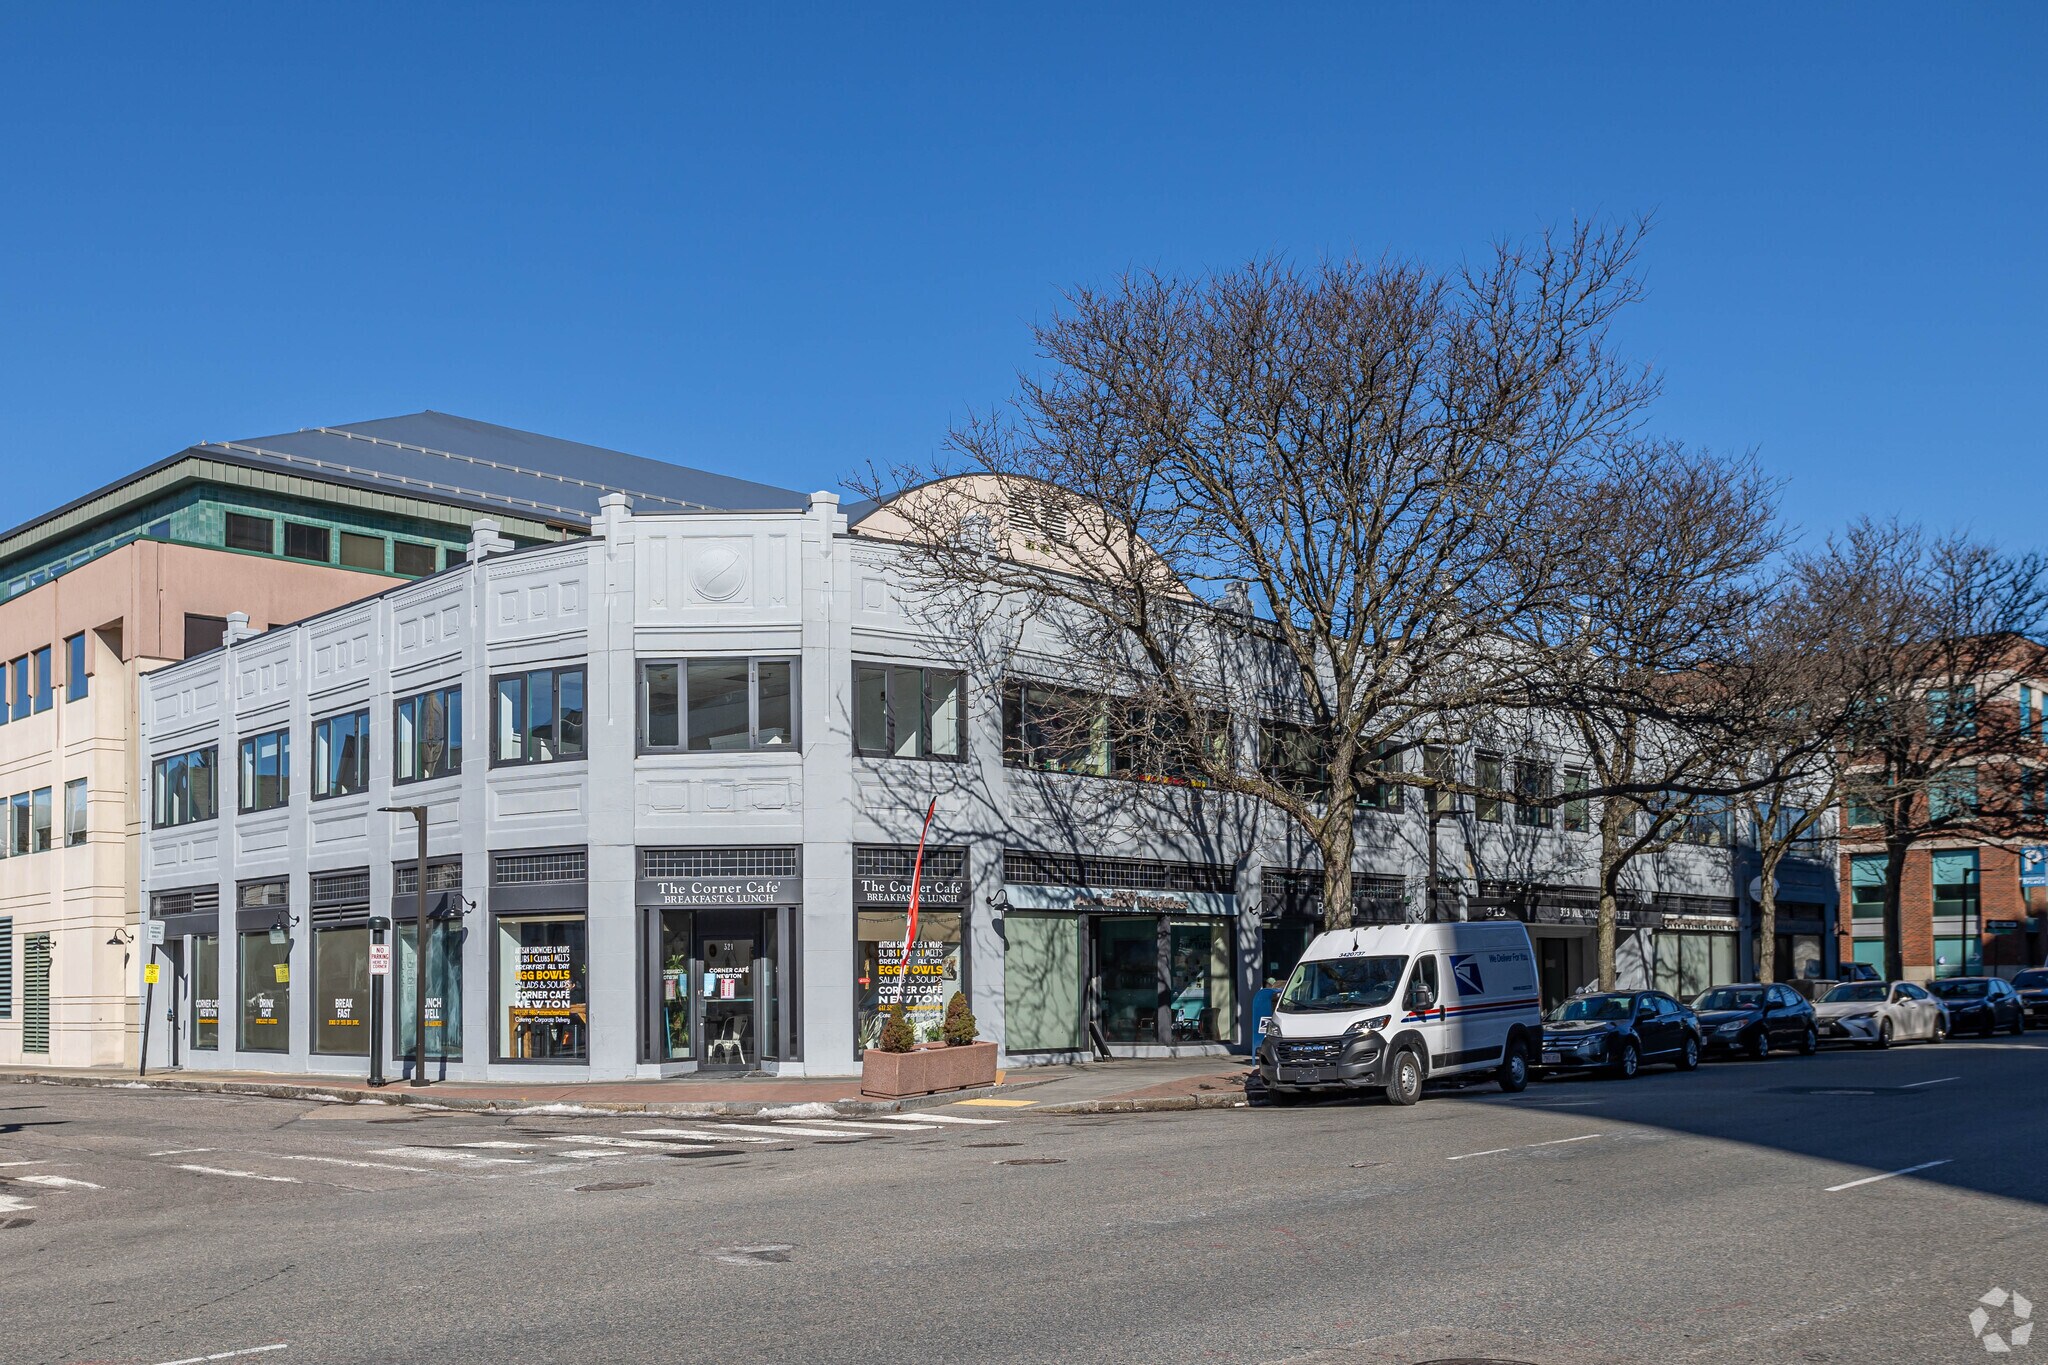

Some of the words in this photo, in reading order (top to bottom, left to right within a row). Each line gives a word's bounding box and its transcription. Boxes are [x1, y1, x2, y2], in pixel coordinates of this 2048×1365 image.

[2025, 850, 2043, 871] P
[658, 882, 685, 894] The
[691, 881, 741, 893] Corner
[861, 880, 885, 892] The
[889, 880, 931, 893] Corer
[664, 895, 724, 904] BREAKFAST
[725, 894, 734, 903] &
[737, 894, 774, 903] LUNCH
[867, 893, 912, 901] BREAKFAS
[927, 894, 958, 903] LUNCH
[1486, 907, 1506, 917] 313
[1572, 908, 1600, 918] WASHING
[530, 946, 553, 954] SANDWICHES
[556, 945, 570, 953] WRAPS
[723, 943, 734, 951] 321
[878, 940, 897, 948] ARTISAN
[928, 941, 943, 949] WRAPS
[878, 949, 897, 957] SUBS
[925, 949, 944, 957] MELTS
[733, 965, 750, 973] CAFÉ
[878, 965, 901, 975] EGG
[515, 971, 535, 980] EGG
[536, 970, 570, 980] BOWLS
[916, 975, 943, 984] SOUPS
[515, 980, 539, 989] SALADS
[539, 980, 547, 989] &
[546, 980, 570, 989] SOUPS
[918, 982, 943, 994] CAFÉ
[515, 990, 549, 999] CORNER
[549, 988, 571, 999] CAFÉ
[195, 999, 211, 1008] CORNER
[211, 999, 219, 1008] CAF
[259, 998, 274, 1008] DRINK
[335, 998, 353, 1008] BREAK
[425, 998, 442, 1008] UNCH
[514, 1000, 571, 1009] NEWTON
[199, 1008, 218, 1017] NEWTON
[261, 1008, 272, 1017] HOT
[337, 1008, 351, 1018] FAST
[425, 1009, 440, 1019] WELL
